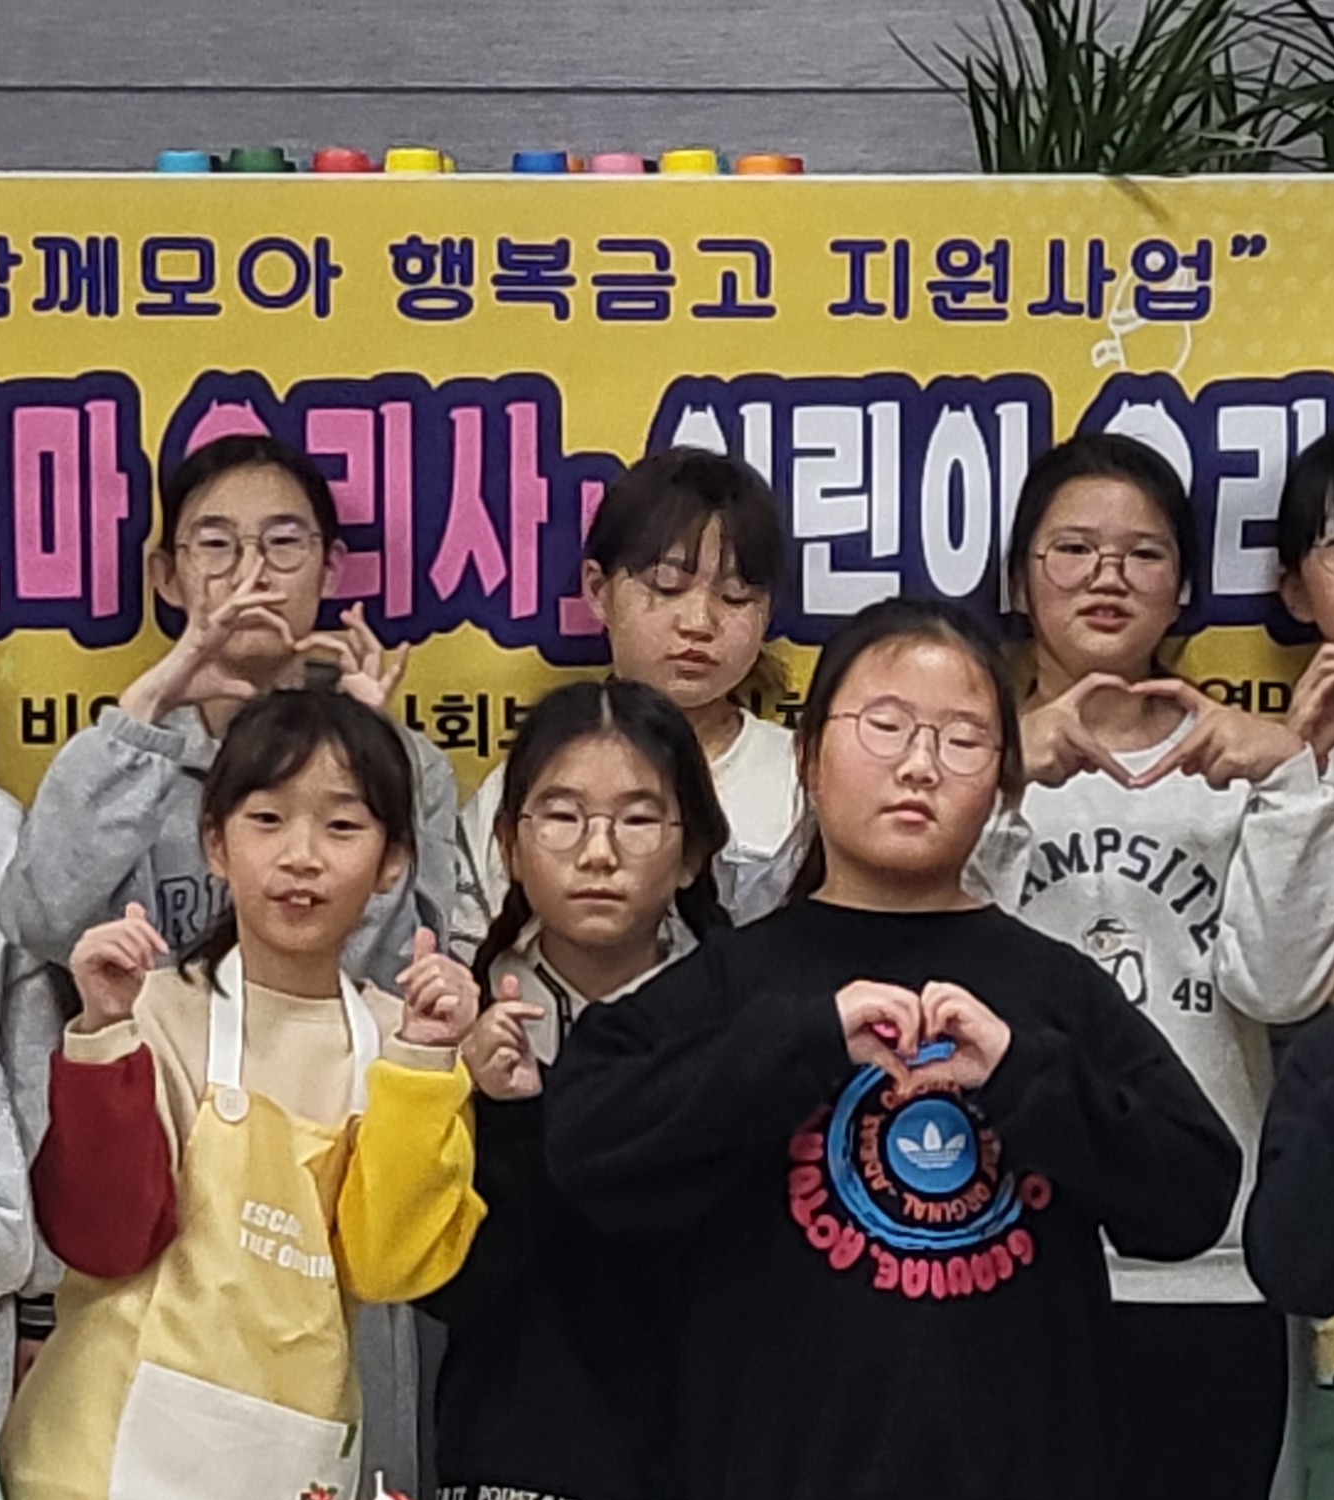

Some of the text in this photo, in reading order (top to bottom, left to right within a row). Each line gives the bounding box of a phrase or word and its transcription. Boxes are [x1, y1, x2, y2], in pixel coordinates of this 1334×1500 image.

[388, 234, 777, 321] 행복금고
[827, 234, 1267, 321] 지원사업”
[1172, 977, 1214, 1014] 49
